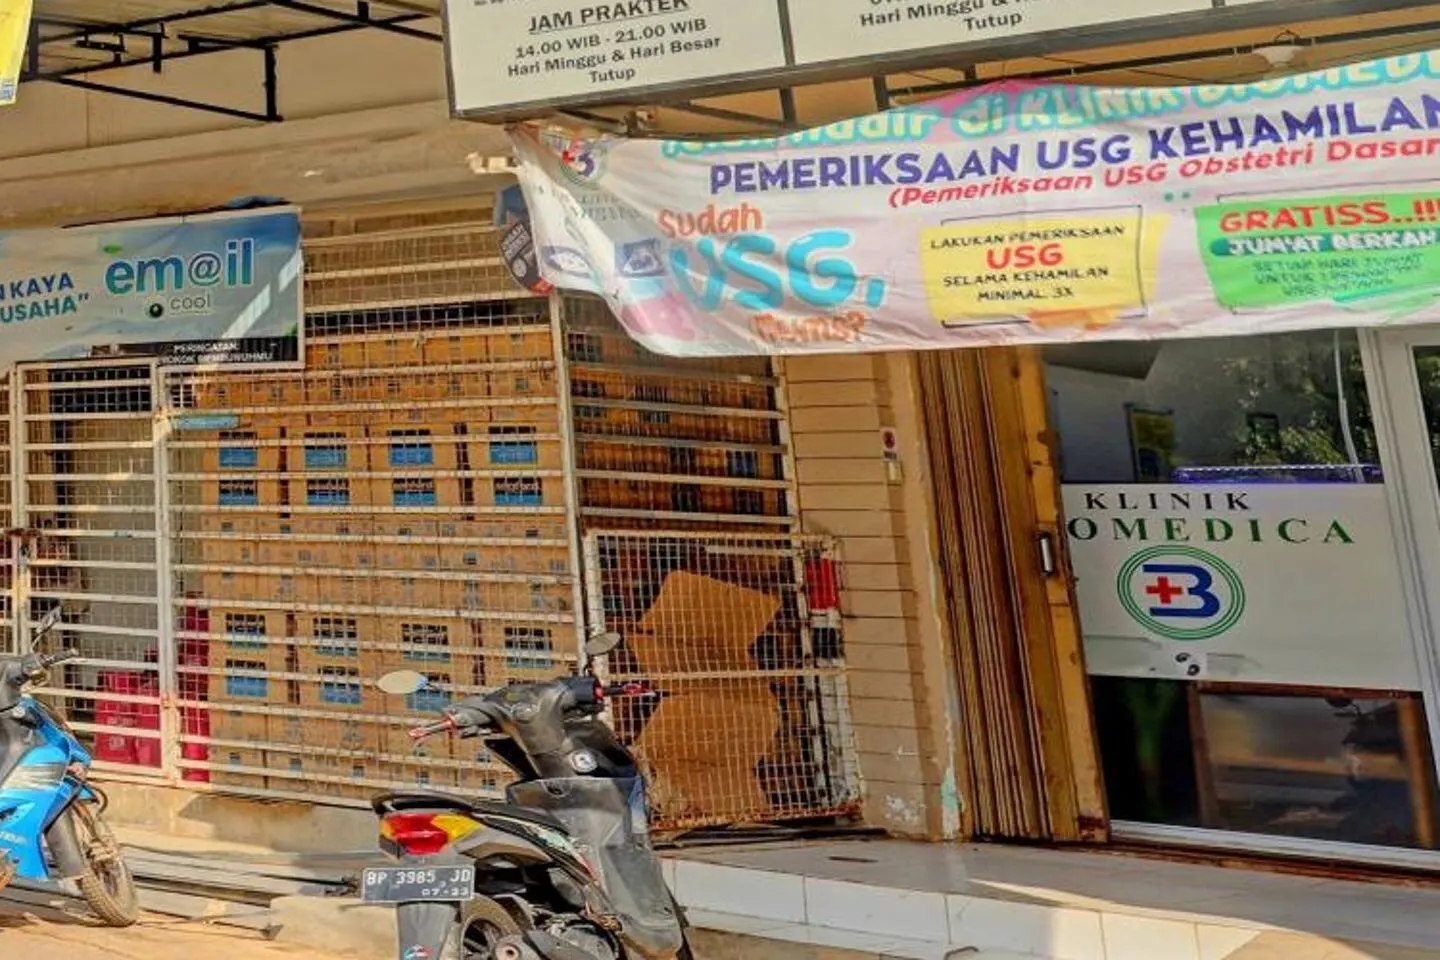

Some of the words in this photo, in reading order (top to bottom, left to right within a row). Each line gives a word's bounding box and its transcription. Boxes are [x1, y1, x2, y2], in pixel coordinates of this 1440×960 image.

[528, 12, 573, 33] JAM
[860, 6, 902, 28] Hari
[963, 10, 1023, 34] Tutup
[516, 40, 562, 60] 14.00
[565, 33, 601, 52] WIB
[615, 24, 667, 45] 21.00
[670, 17, 707, 37] WIB
[507, 58, 541, 77] Hari
[545, 52, 607, 76] Minggu
[612, 49, 626, 62] &
[629, 42, 665, 59] Hari
[670, 35, 721, 55] Besar
[589, 65, 636, 85] Tutup
[710, 143, 1019, 195] PEMERIKSAAN
[1037, 133, 1131, 171] USG
[1148, 93, 1440, 161] KEHAMILAN
[888, 174, 1092, 209] (Pemeriksaan
[1104, 158, 1166, 187] USG
[1179, 142, 1313, 179] Obstetri
[1327, 137, 1438, 161] Dasar
[105, 238, 255, 296] em@il
[986, 243, 1064, 270] USG
[9, 272, 75, 301] KAYA
[943, 273, 1007, 288] SELAMA
[1013, 266, 1109, 282] KEHAMILAN
[170, 293, 212, 313] cool
[977, 288, 1047, 302] MINIMAL
[1084, 492, 1250, 511] KLINIK
[366, 871, 388, 886] BP
[395, 869, 436, 885] 3985
[449, 868, 471, 882] JD
